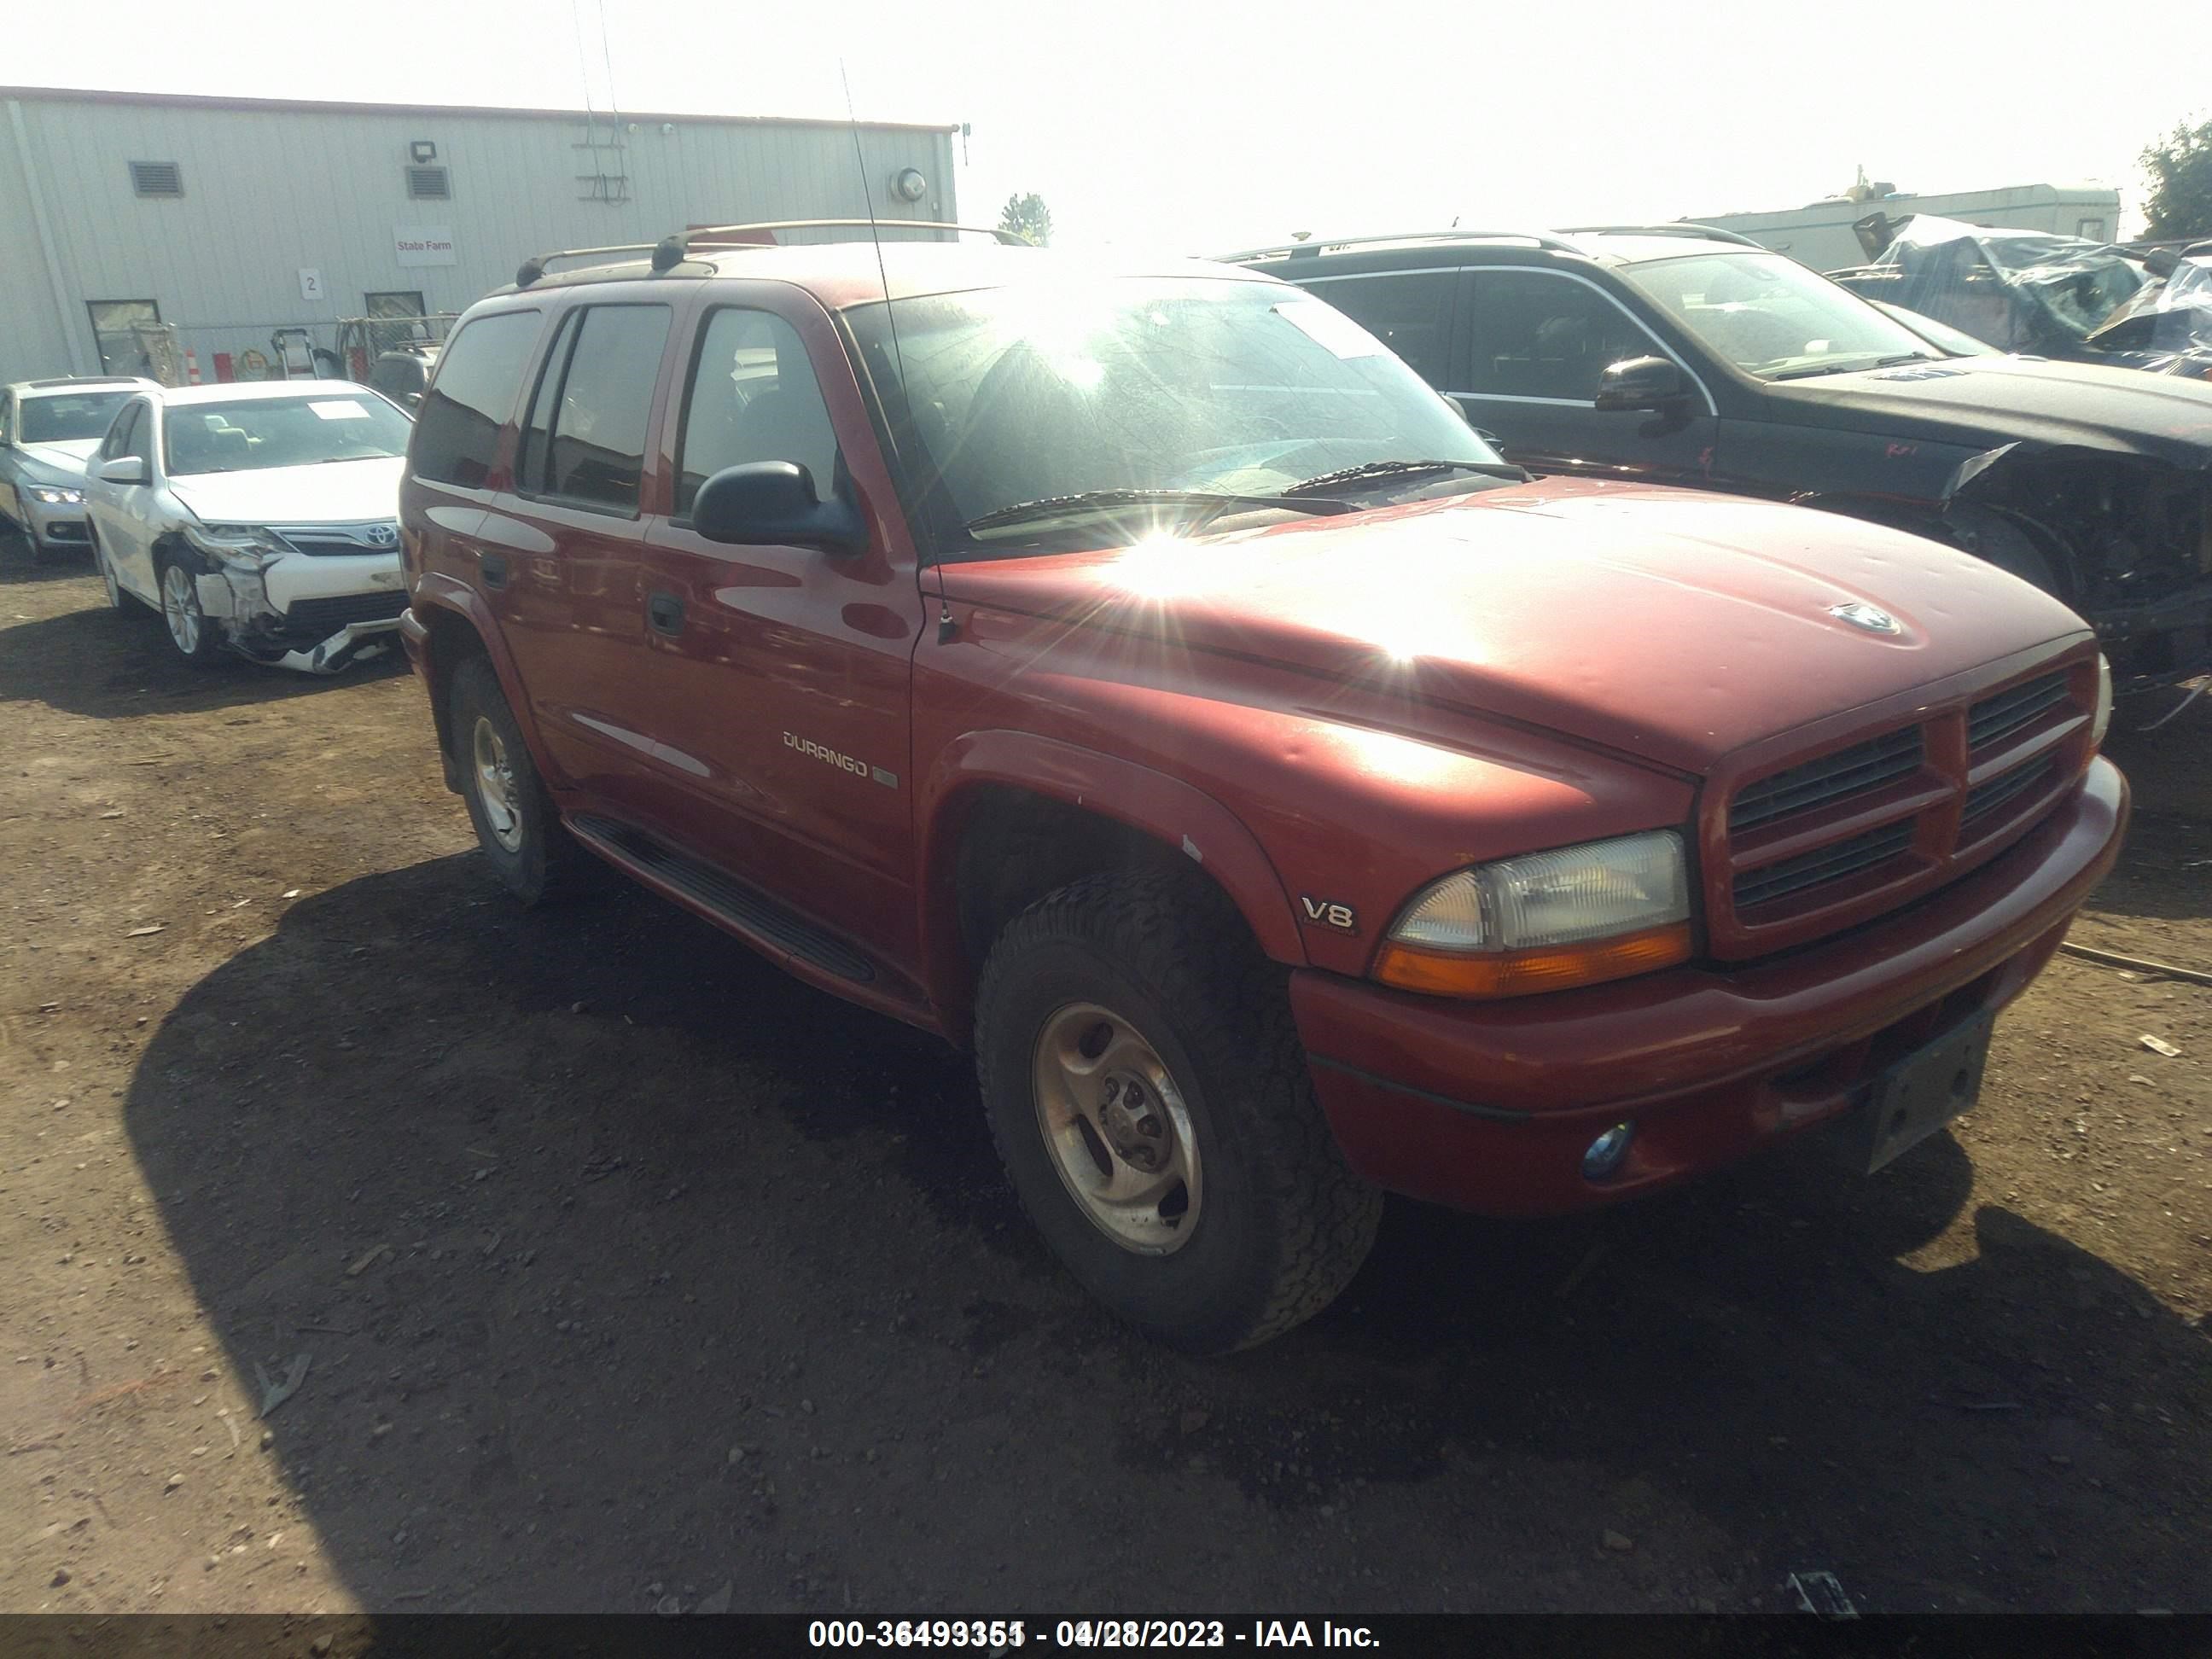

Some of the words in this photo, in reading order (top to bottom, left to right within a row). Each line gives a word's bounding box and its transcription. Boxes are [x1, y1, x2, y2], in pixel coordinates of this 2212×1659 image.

[397, 241, 424, 251] State
[426, 240, 451, 250] Farm
[306, 276, 316, 291] 2
[783, 731, 868, 777] DURANGO
[1301, 897, 1353, 928] V8
